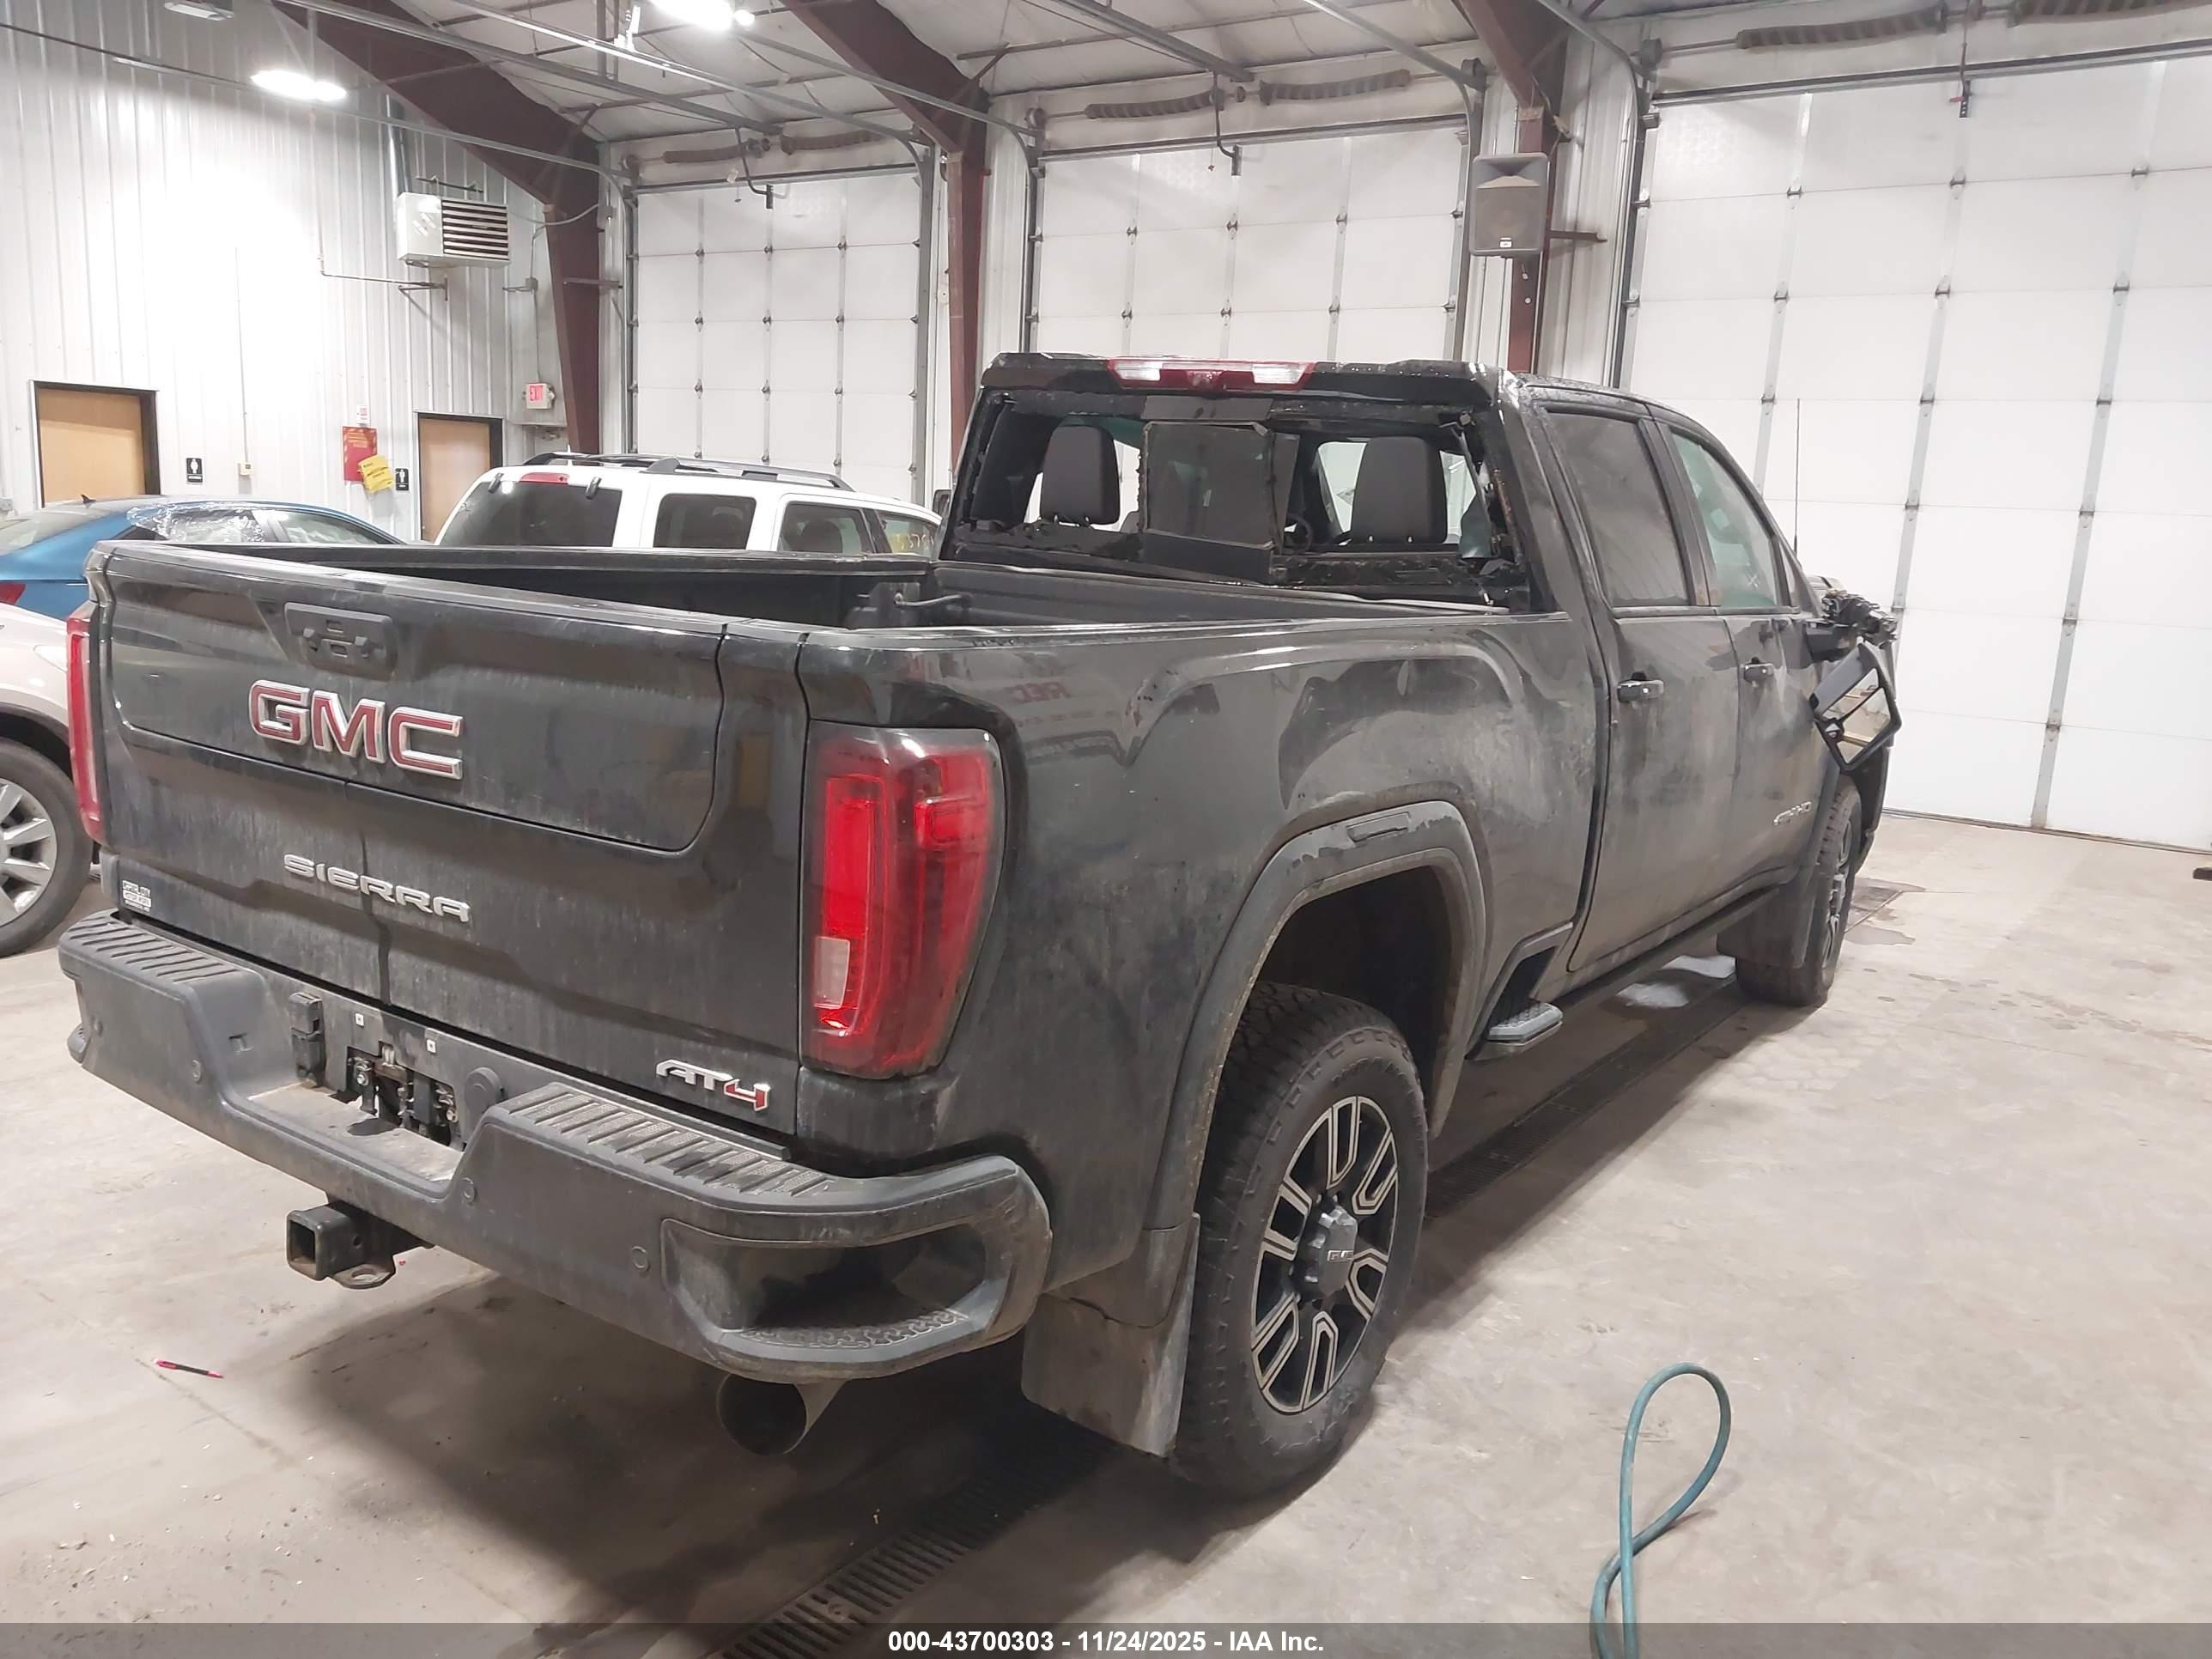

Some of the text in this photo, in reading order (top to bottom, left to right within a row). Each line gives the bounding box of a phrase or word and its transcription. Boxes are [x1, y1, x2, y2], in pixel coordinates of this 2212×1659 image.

[248, 679, 463, 781] GMC
[283, 854, 471, 923] SIERRA
[655, 1059, 771, 1111] AT4
